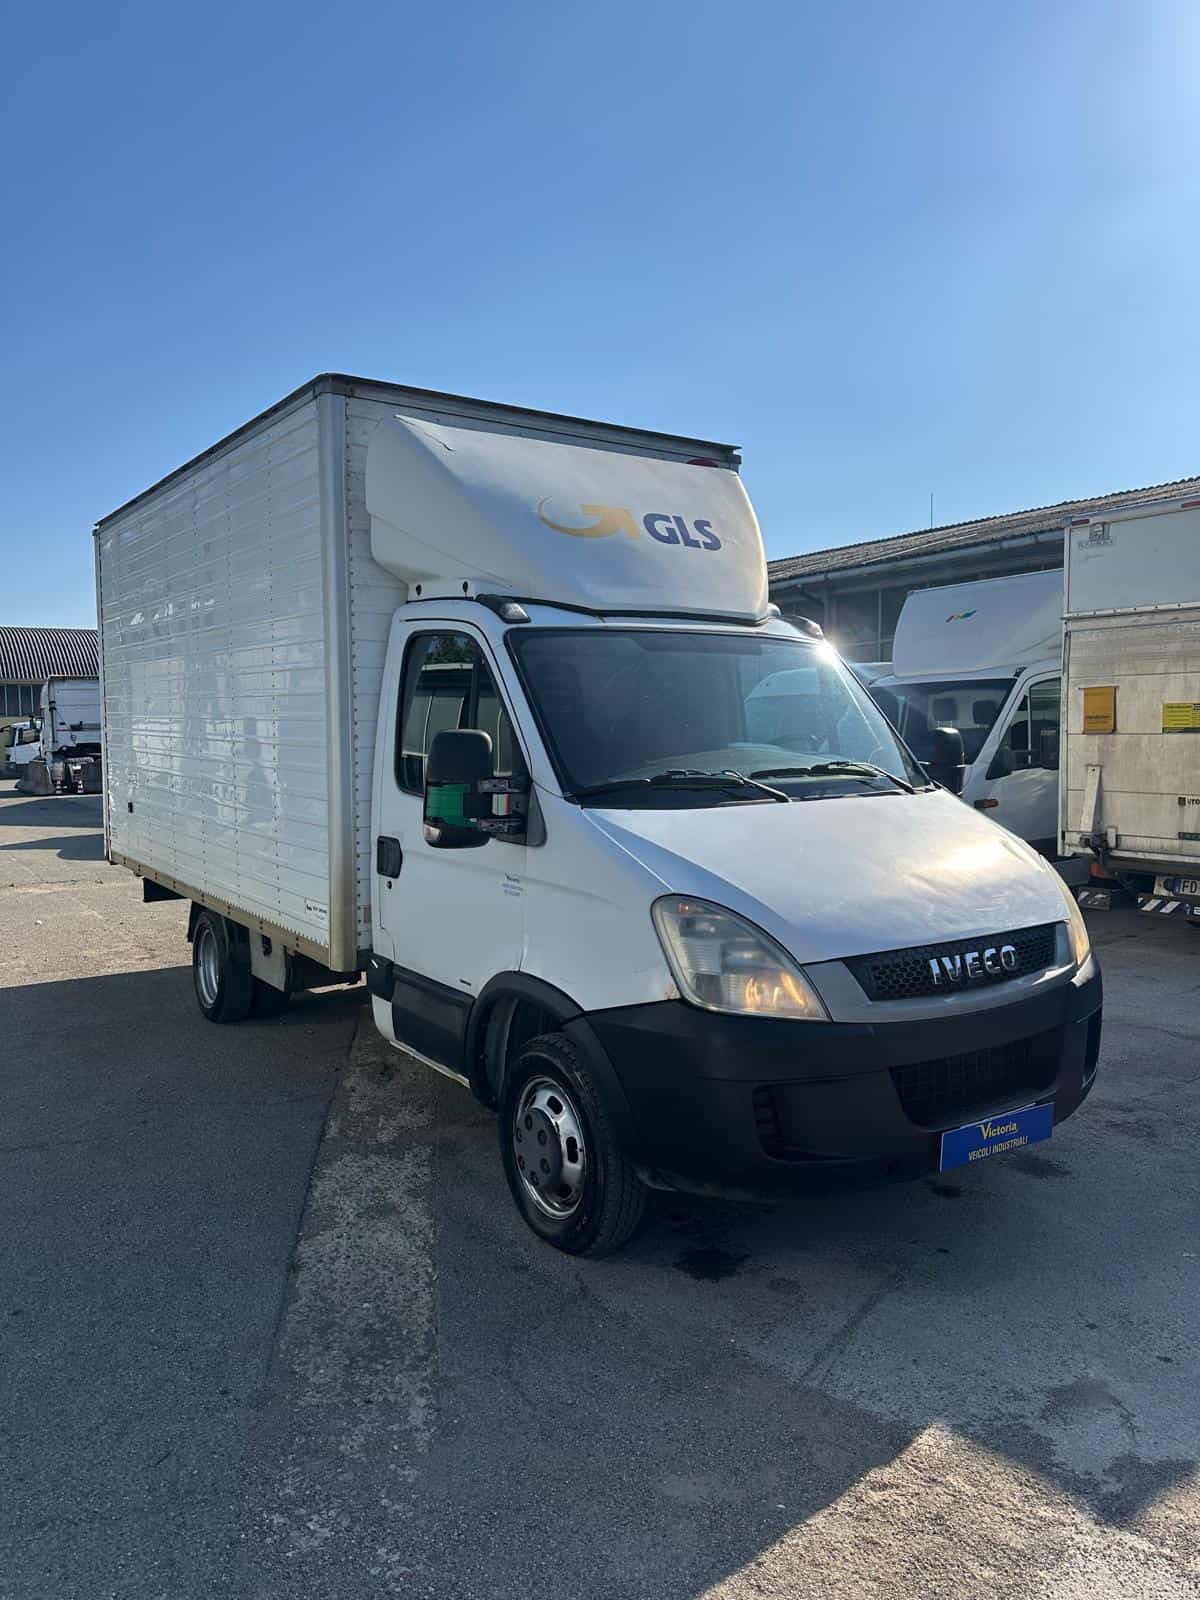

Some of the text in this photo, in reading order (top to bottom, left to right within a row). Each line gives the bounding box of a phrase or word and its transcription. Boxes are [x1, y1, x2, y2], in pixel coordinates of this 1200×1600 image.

[643, 512, 722, 552] GLS
[928, 945, 1017, 985] IVECO
[977, 1121, 1018, 1140] Victoria
[968, 1136, 1028, 1161] VEICOLI INDUSTRIALI
